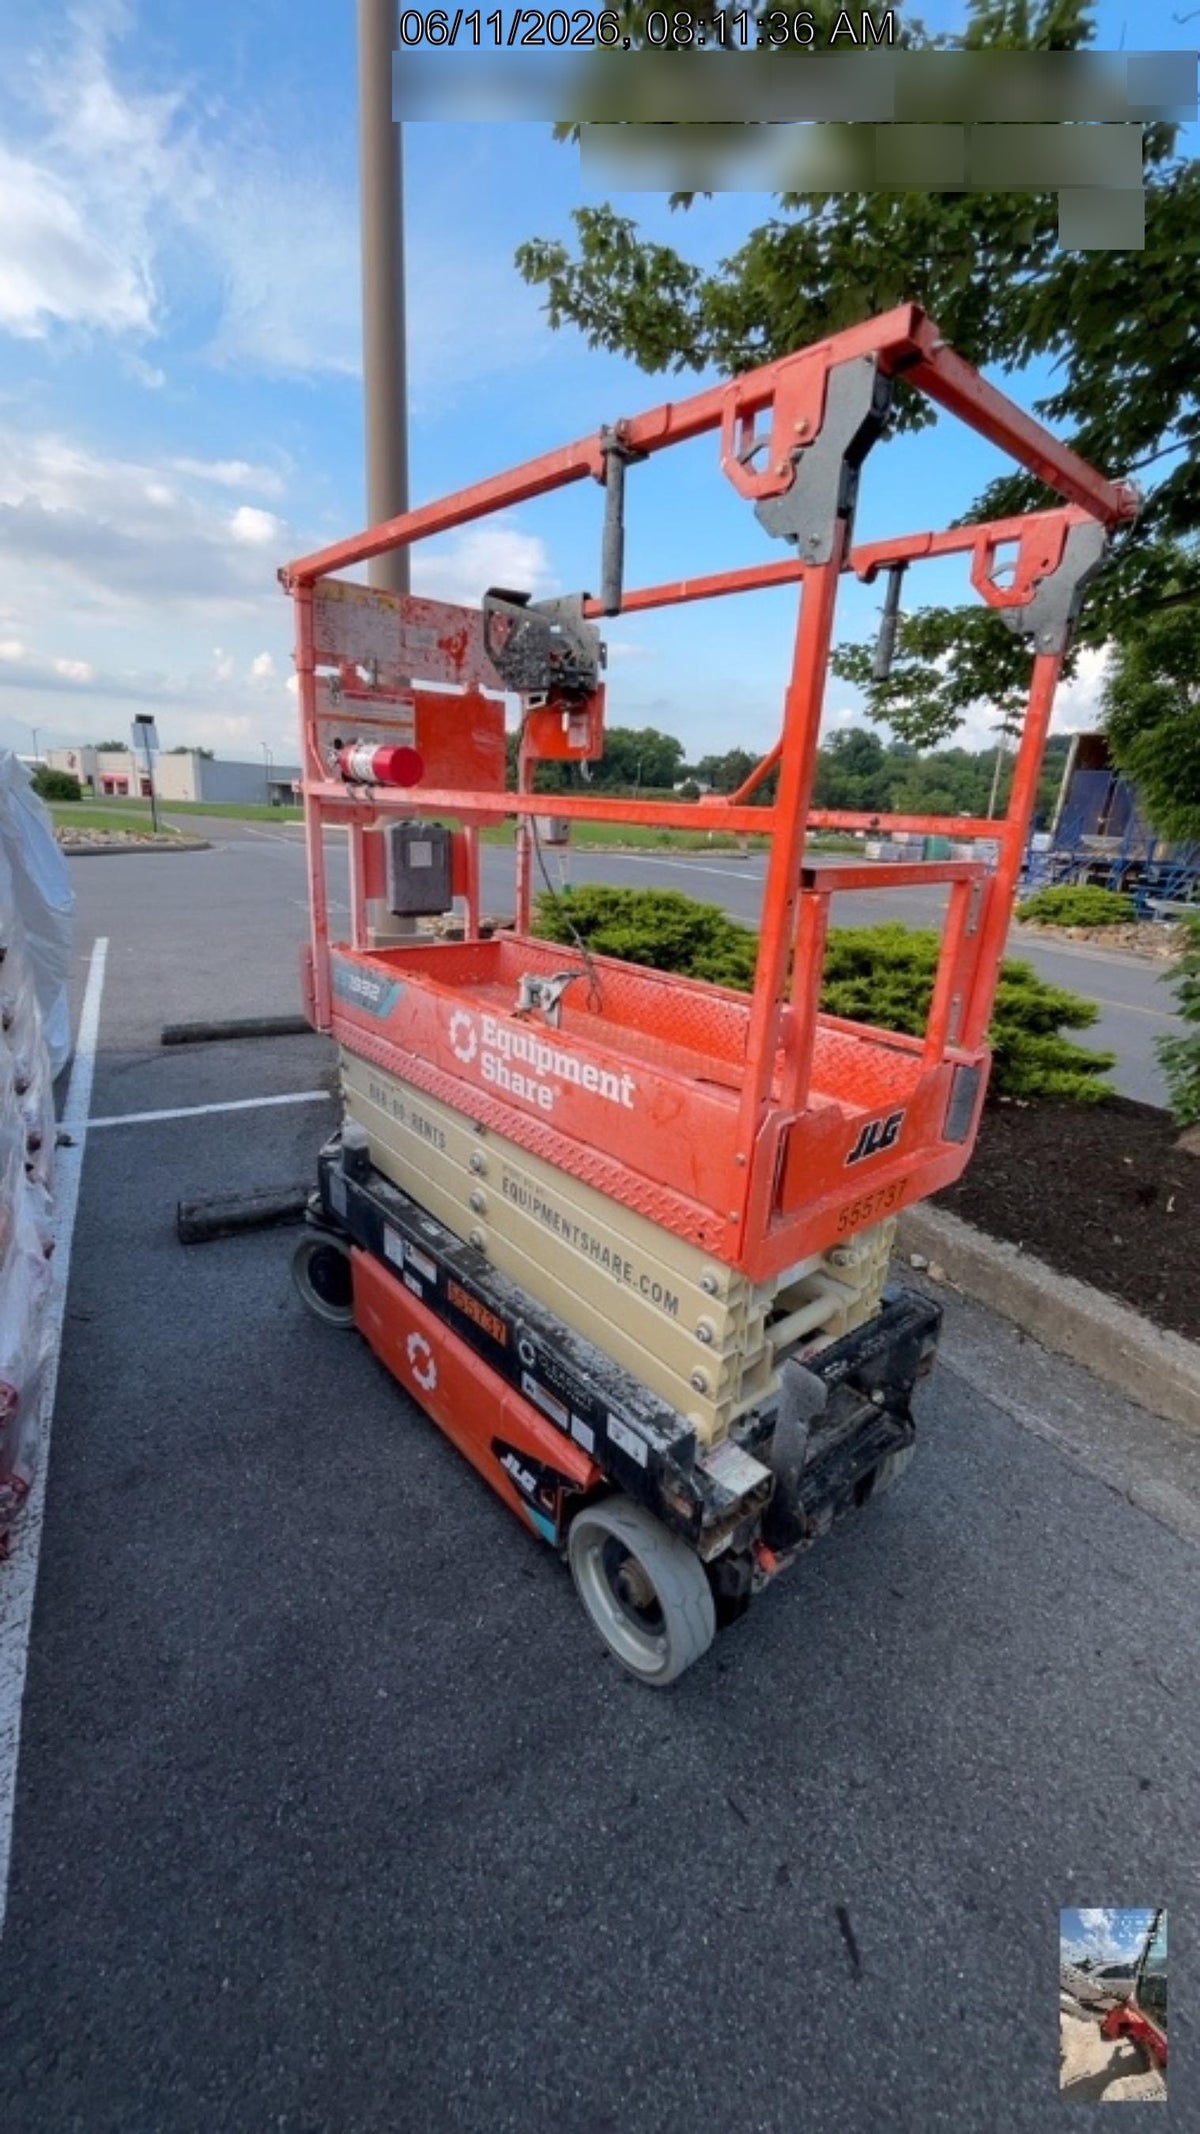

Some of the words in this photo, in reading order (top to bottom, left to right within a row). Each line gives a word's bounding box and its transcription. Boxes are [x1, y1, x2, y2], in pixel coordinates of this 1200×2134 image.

[481, 1014, 636, 1110] Equipment
[844, 1108, 906, 1167] JLG
[836, 1177, 909, 1232] 555737
[501, 1176, 681, 1316] EQUIPMENTSHARE.COM
[500, 1452, 537, 1493] JLG
